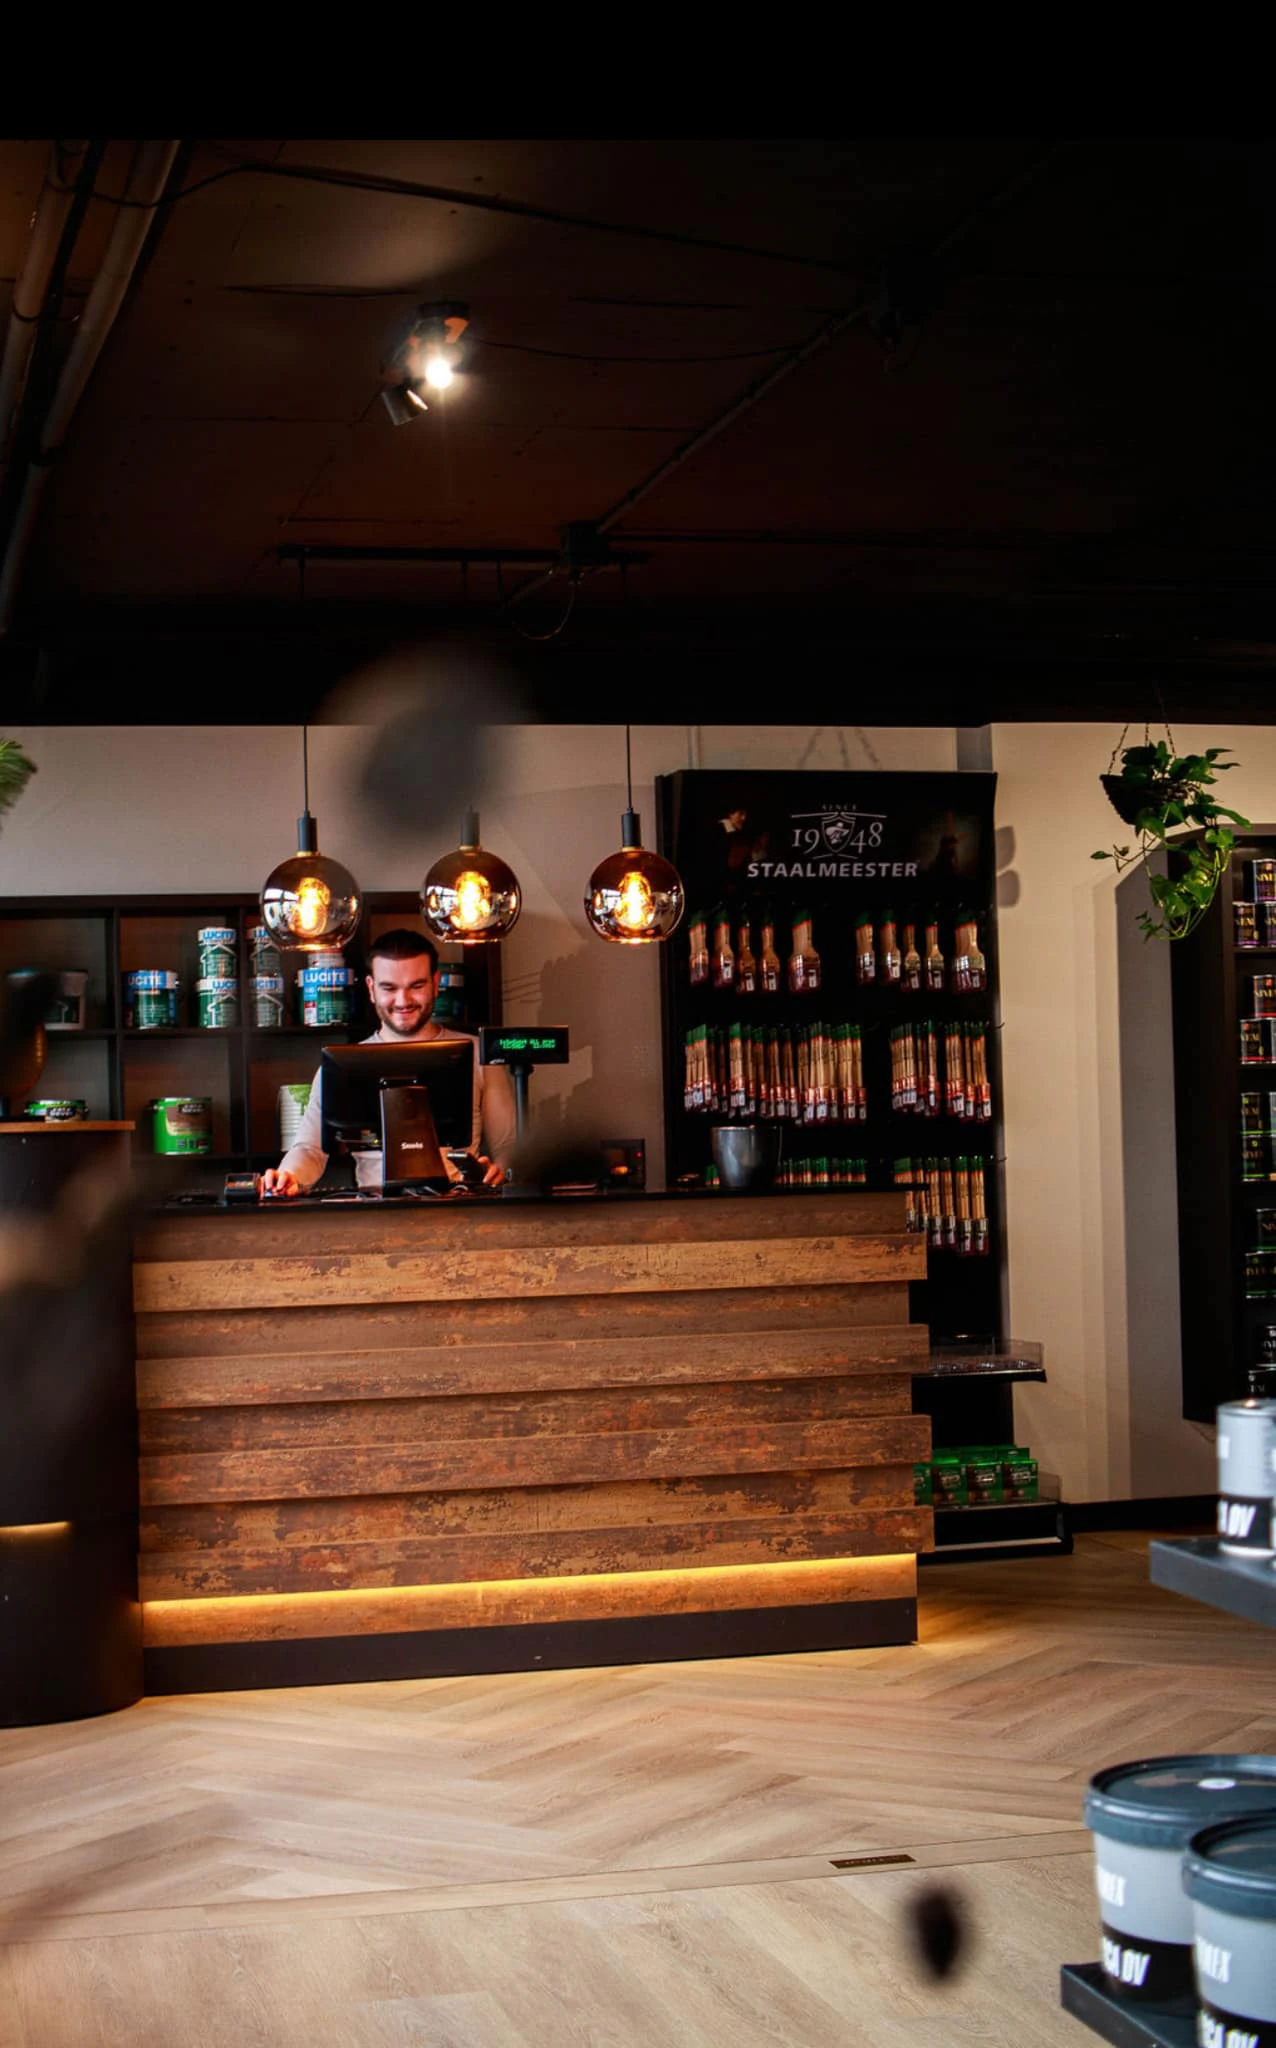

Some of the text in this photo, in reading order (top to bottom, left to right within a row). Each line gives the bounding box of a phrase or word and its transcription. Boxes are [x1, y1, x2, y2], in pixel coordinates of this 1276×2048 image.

[747, 862, 918, 878] STAALMEESTER
[127, 975, 162, 986] UCITE
[304, 971, 345, 984] LUCITE
